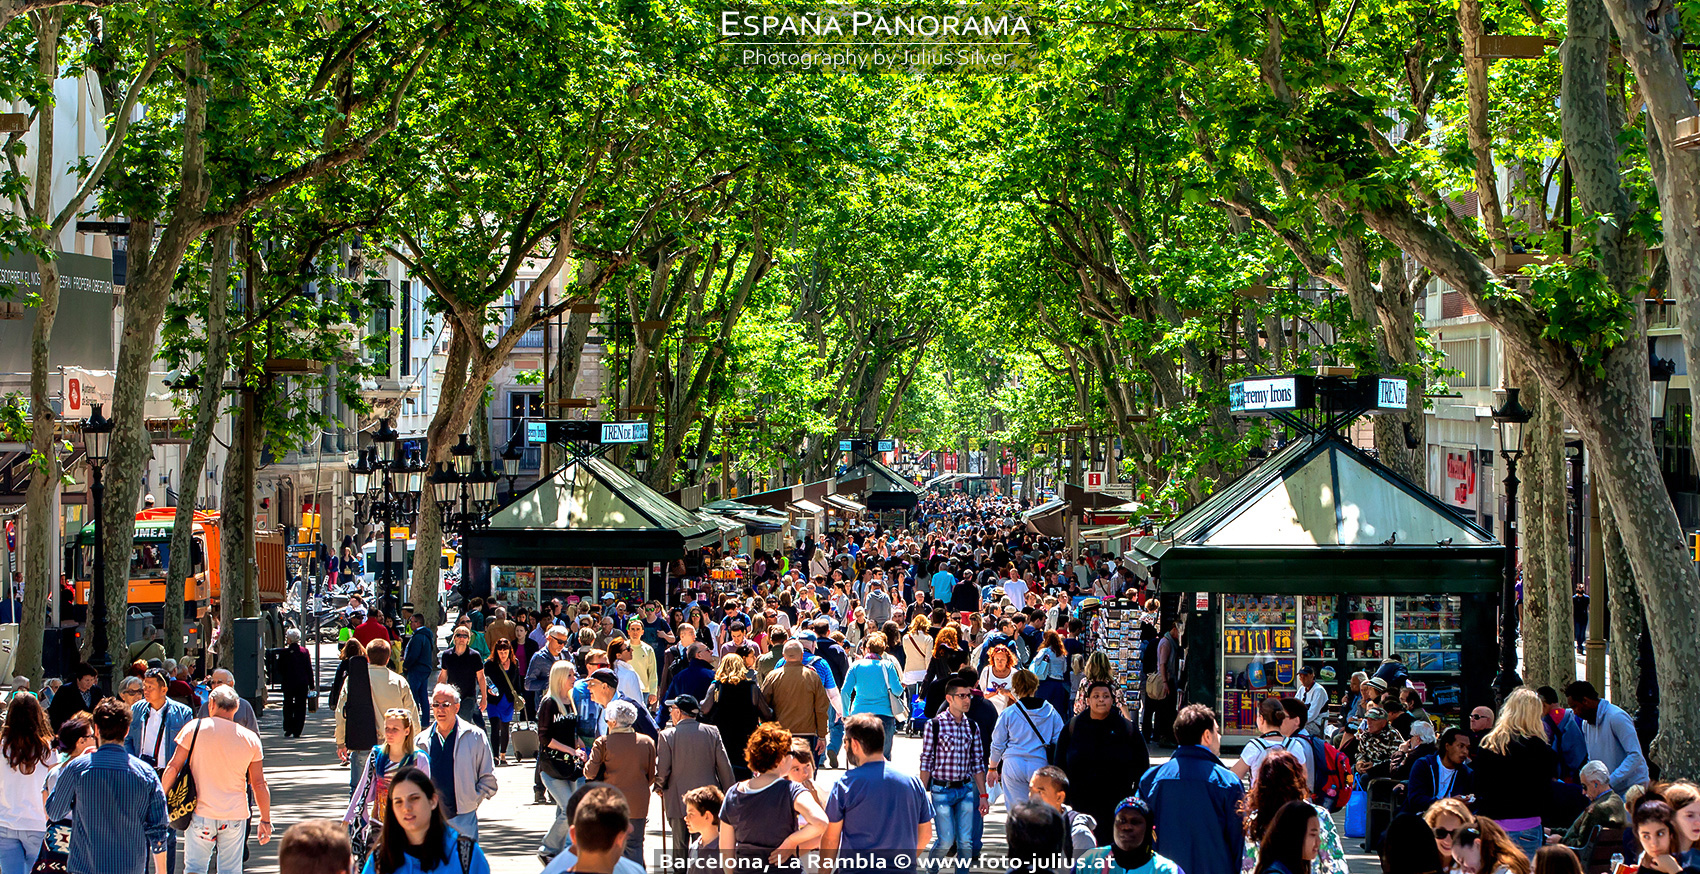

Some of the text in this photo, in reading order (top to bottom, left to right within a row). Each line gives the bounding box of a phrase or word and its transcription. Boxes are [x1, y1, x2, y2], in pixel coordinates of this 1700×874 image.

[1270, 384, 1292, 403] Irons
[1381, 381, 1398, 404] TREN
[604, 424, 624, 441] TREN
